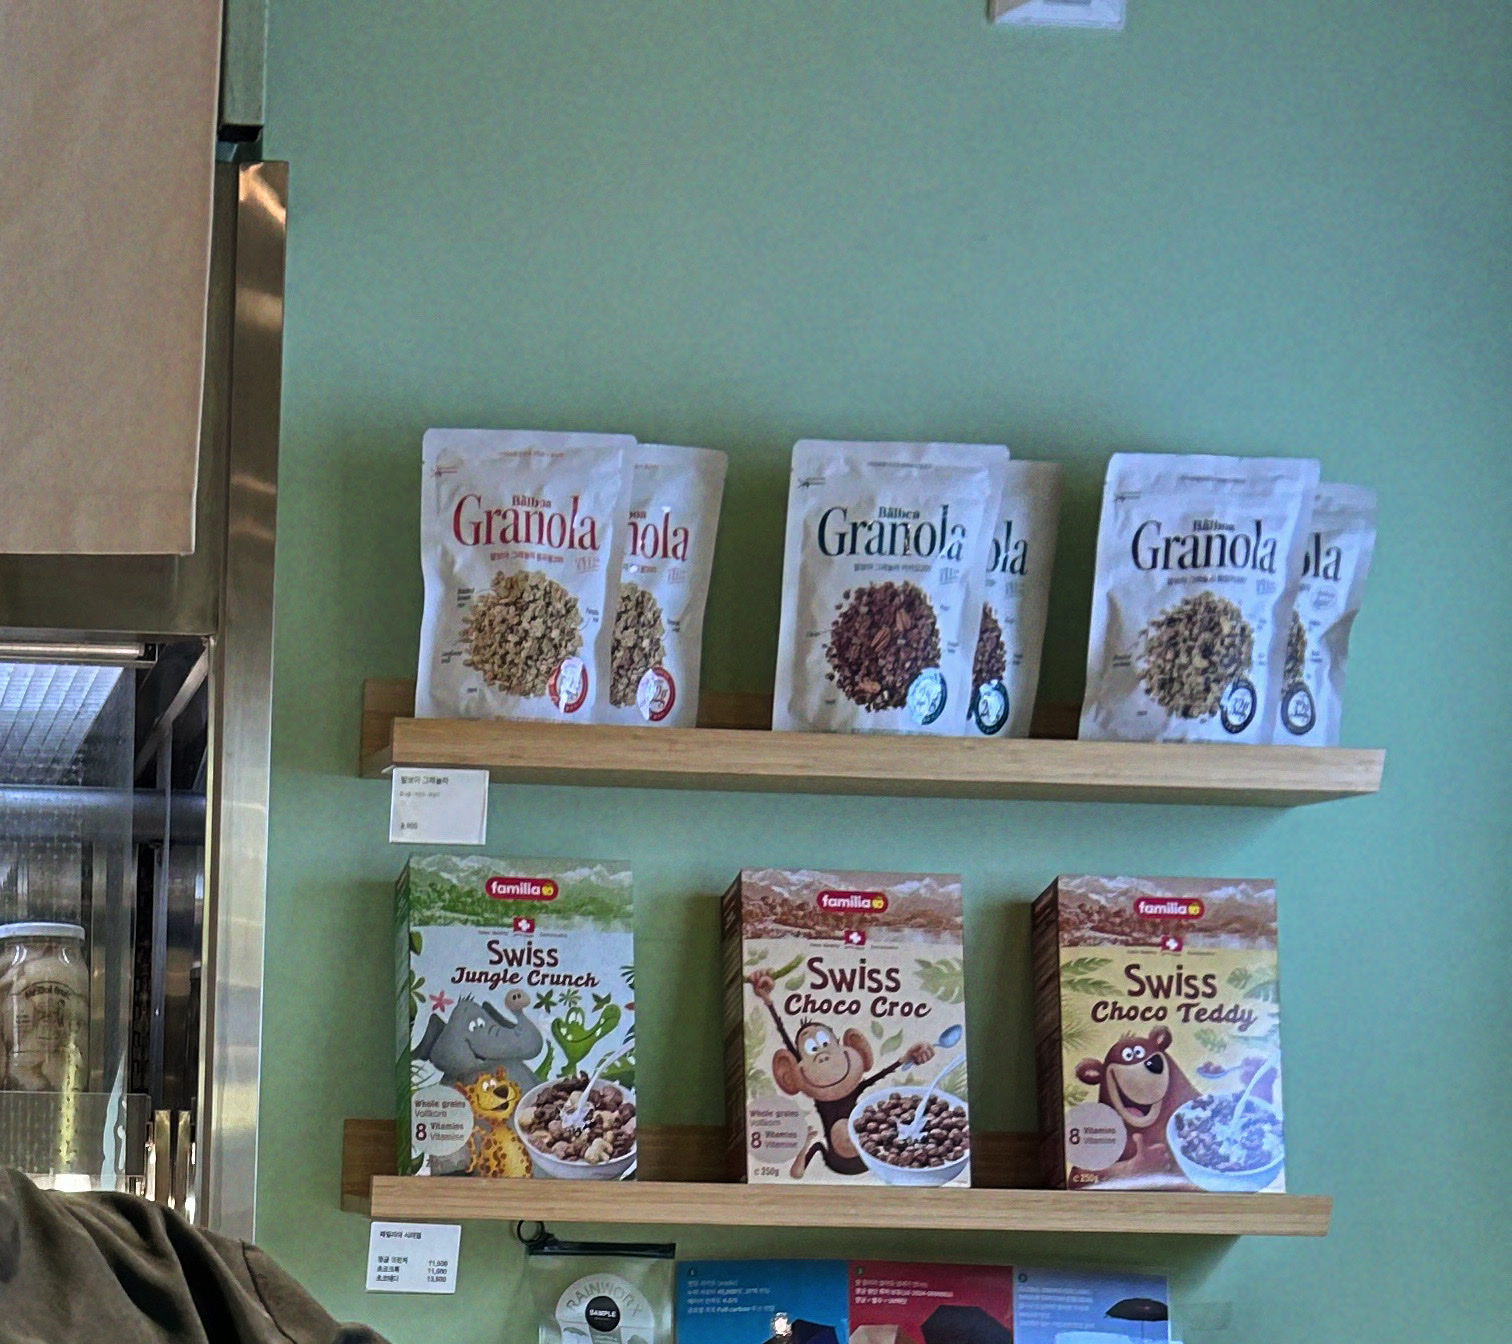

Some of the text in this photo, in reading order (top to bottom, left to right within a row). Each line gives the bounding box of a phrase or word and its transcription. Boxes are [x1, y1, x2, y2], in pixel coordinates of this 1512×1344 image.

[452, 493, 600, 551] Granola
[818, 504, 966, 562] Granola
[628, 510, 690, 562] nola
[1131, 519, 1278, 574] Granola
[491, 881, 541, 896] familia
[821, 894, 871, 910] familia
[1138, 901, 1187, 915] familia
[486, 939, 559, 968] Swiss
[450, 967, 600, 990] Jungle Crunch
[807, 956, 902, 994] Swiss
[1123, 963, 1218, 1000] Swiss
[784, 993, 933, 1018] Choco Croc
[1091, 1000, 1258, 1033] Choco Teddy
[414, 1099, 466, 1110] Whole grains
[415, 1122, 427, 1141] 8
[751, 1131, 762, 1149] 8
[1069, 1127, 1081, 1145] 8
[760, 1166, 780, 1178] 250g
[565, 1281, 643, 1318] RAINWORX
[589, 1307, 617, 1318] SAMPLE
